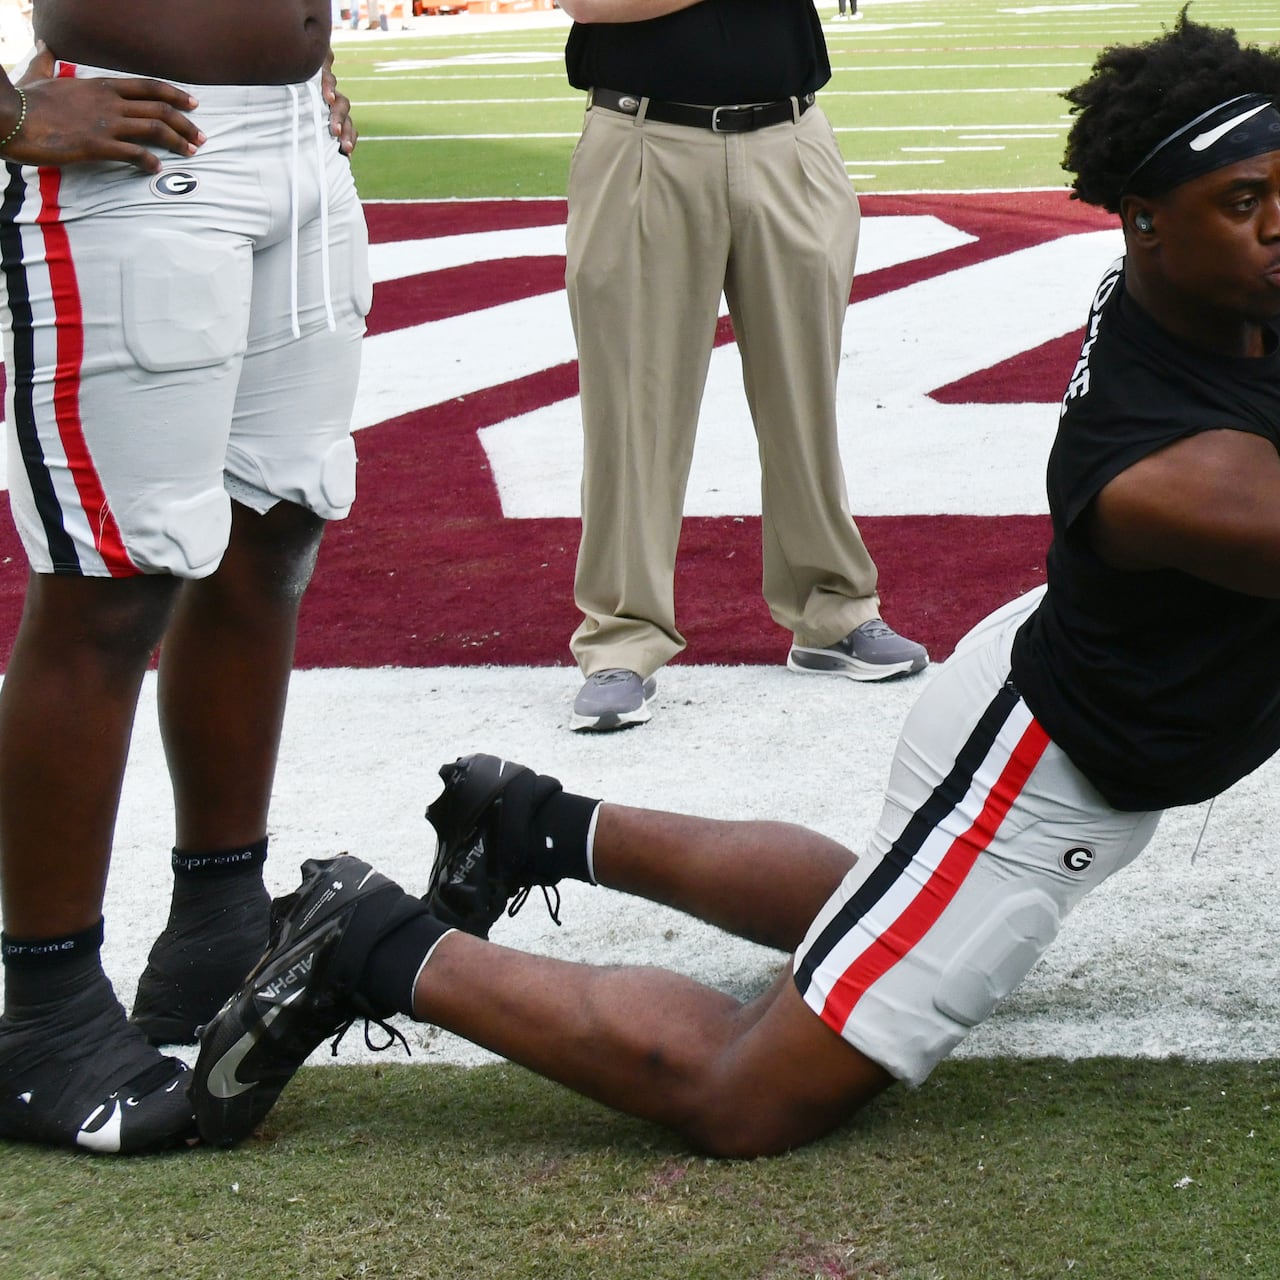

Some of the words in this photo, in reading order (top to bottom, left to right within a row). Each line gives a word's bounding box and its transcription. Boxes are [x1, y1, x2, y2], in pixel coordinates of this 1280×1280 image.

[155, 171, 199, 196] G
[172, 850, 253, 870] Supreme
[1062, 846, 1094, 872] G
[6, 939, 75, 955] preme
[257, 951, 315, 999] ALPHA
